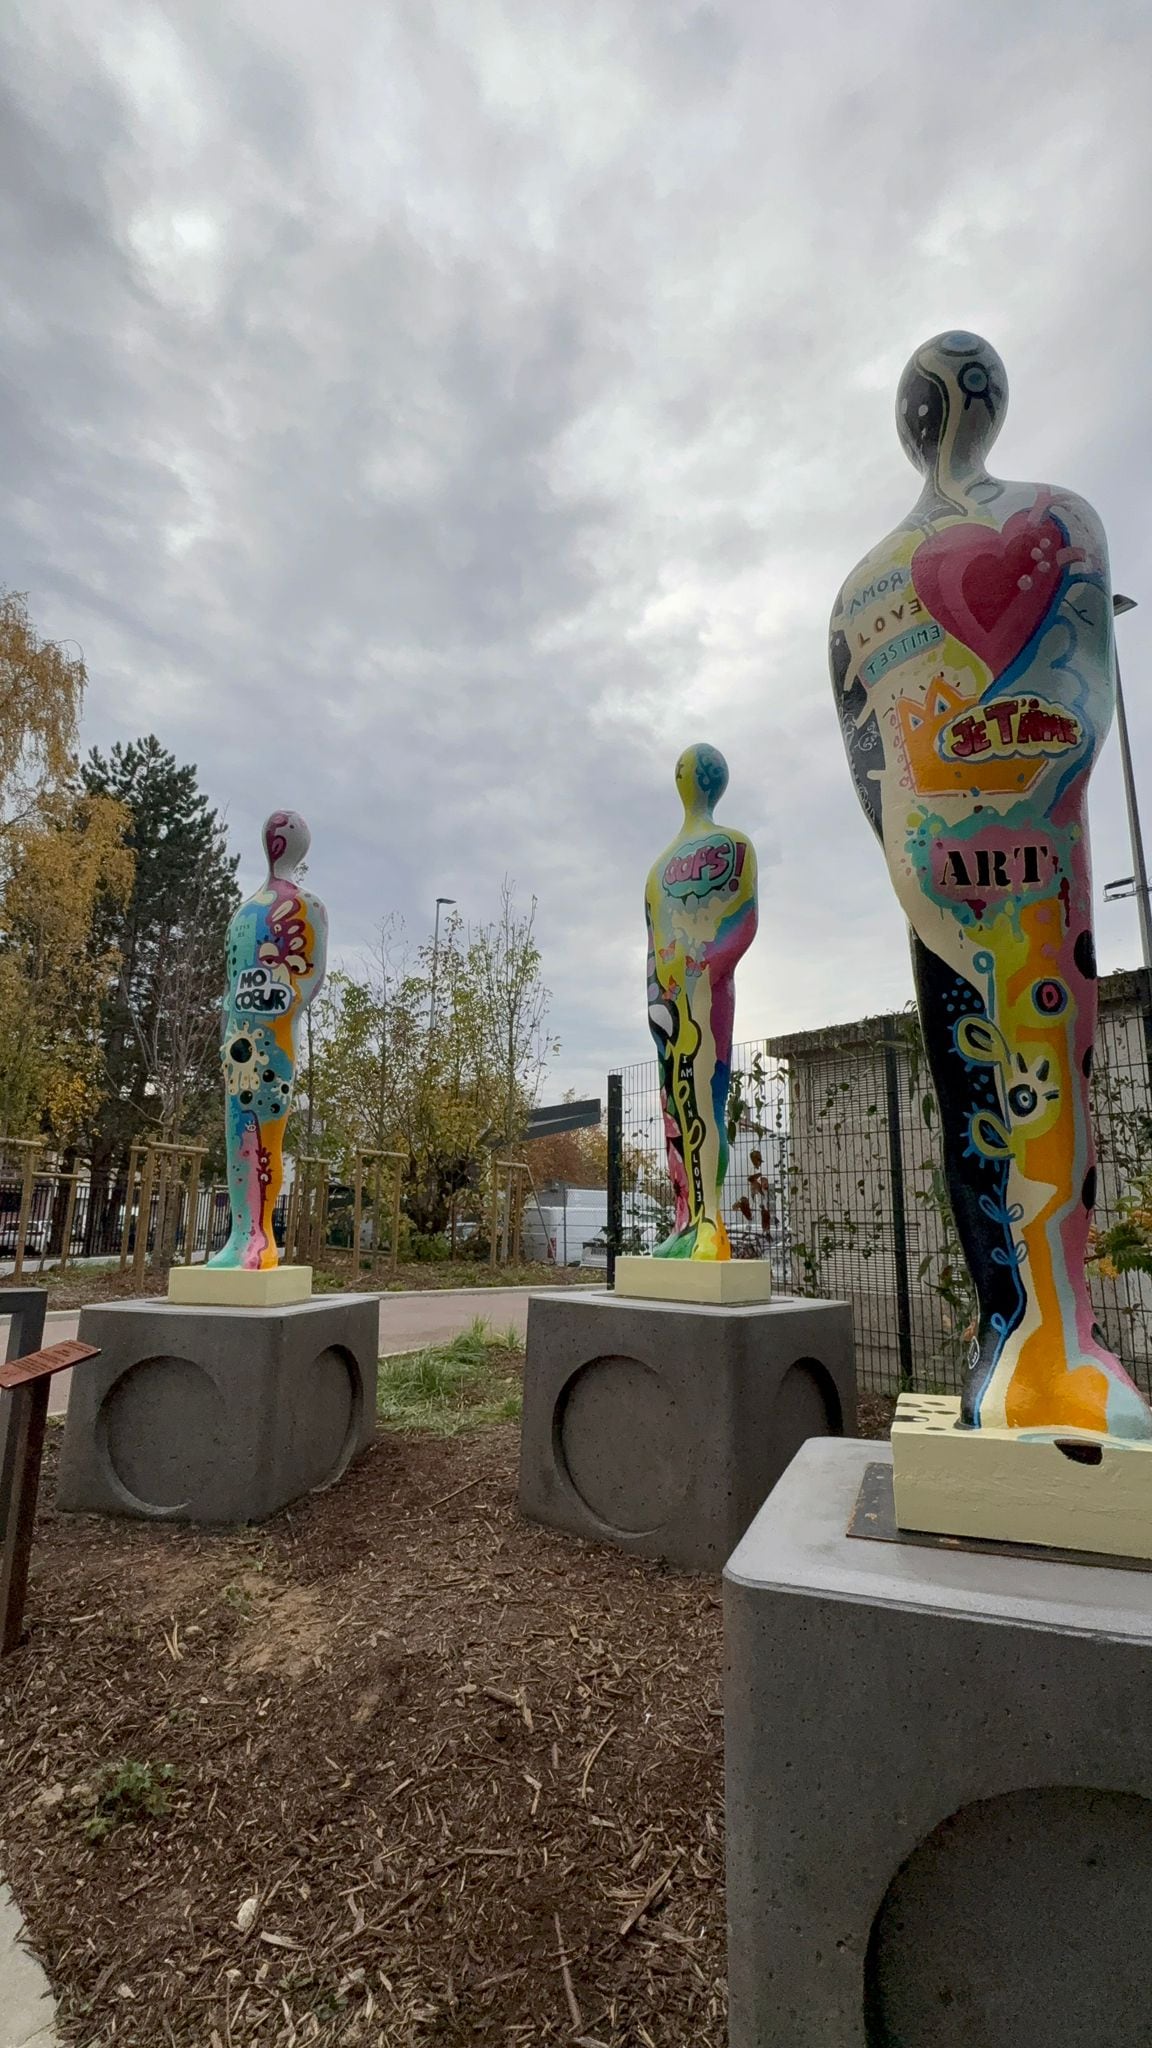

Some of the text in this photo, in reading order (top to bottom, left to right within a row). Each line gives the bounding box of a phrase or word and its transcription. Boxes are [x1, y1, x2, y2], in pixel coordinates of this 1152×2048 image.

[849, 571, 903, 616] AMOR
[857, 598, 922, 648] LOVE
[951, 715, 992, 757] JE
[939, 845, 1049, 887] ART
[239, 969, 267, 989] MO
[680, 1067, 693, 1078] AM
[692, 1153, 702, 1203] LOVE
